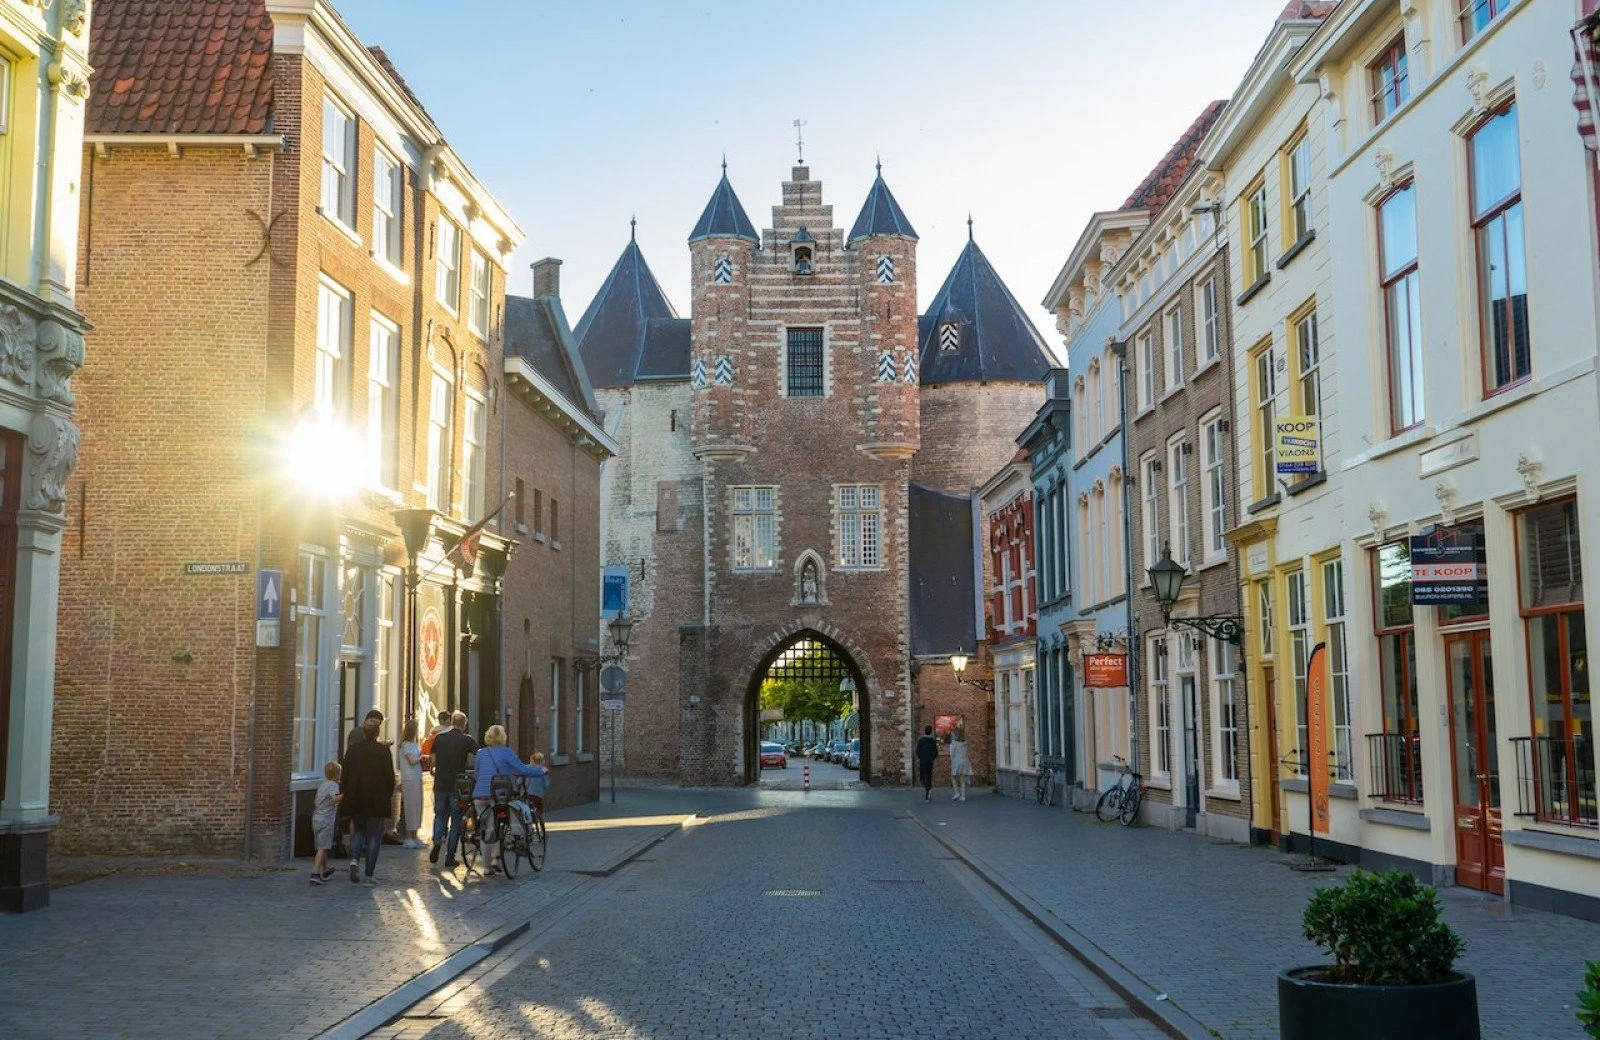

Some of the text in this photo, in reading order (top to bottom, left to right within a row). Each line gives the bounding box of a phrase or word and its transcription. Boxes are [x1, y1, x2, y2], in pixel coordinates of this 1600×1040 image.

[1277, 422, 1314, 432] KOOP
[188, 564, 246, 572] LONDONSTRAAT
[1434, 568, 1472, 576] KOOP
[1089, 656, 1122, 666] Perfect
